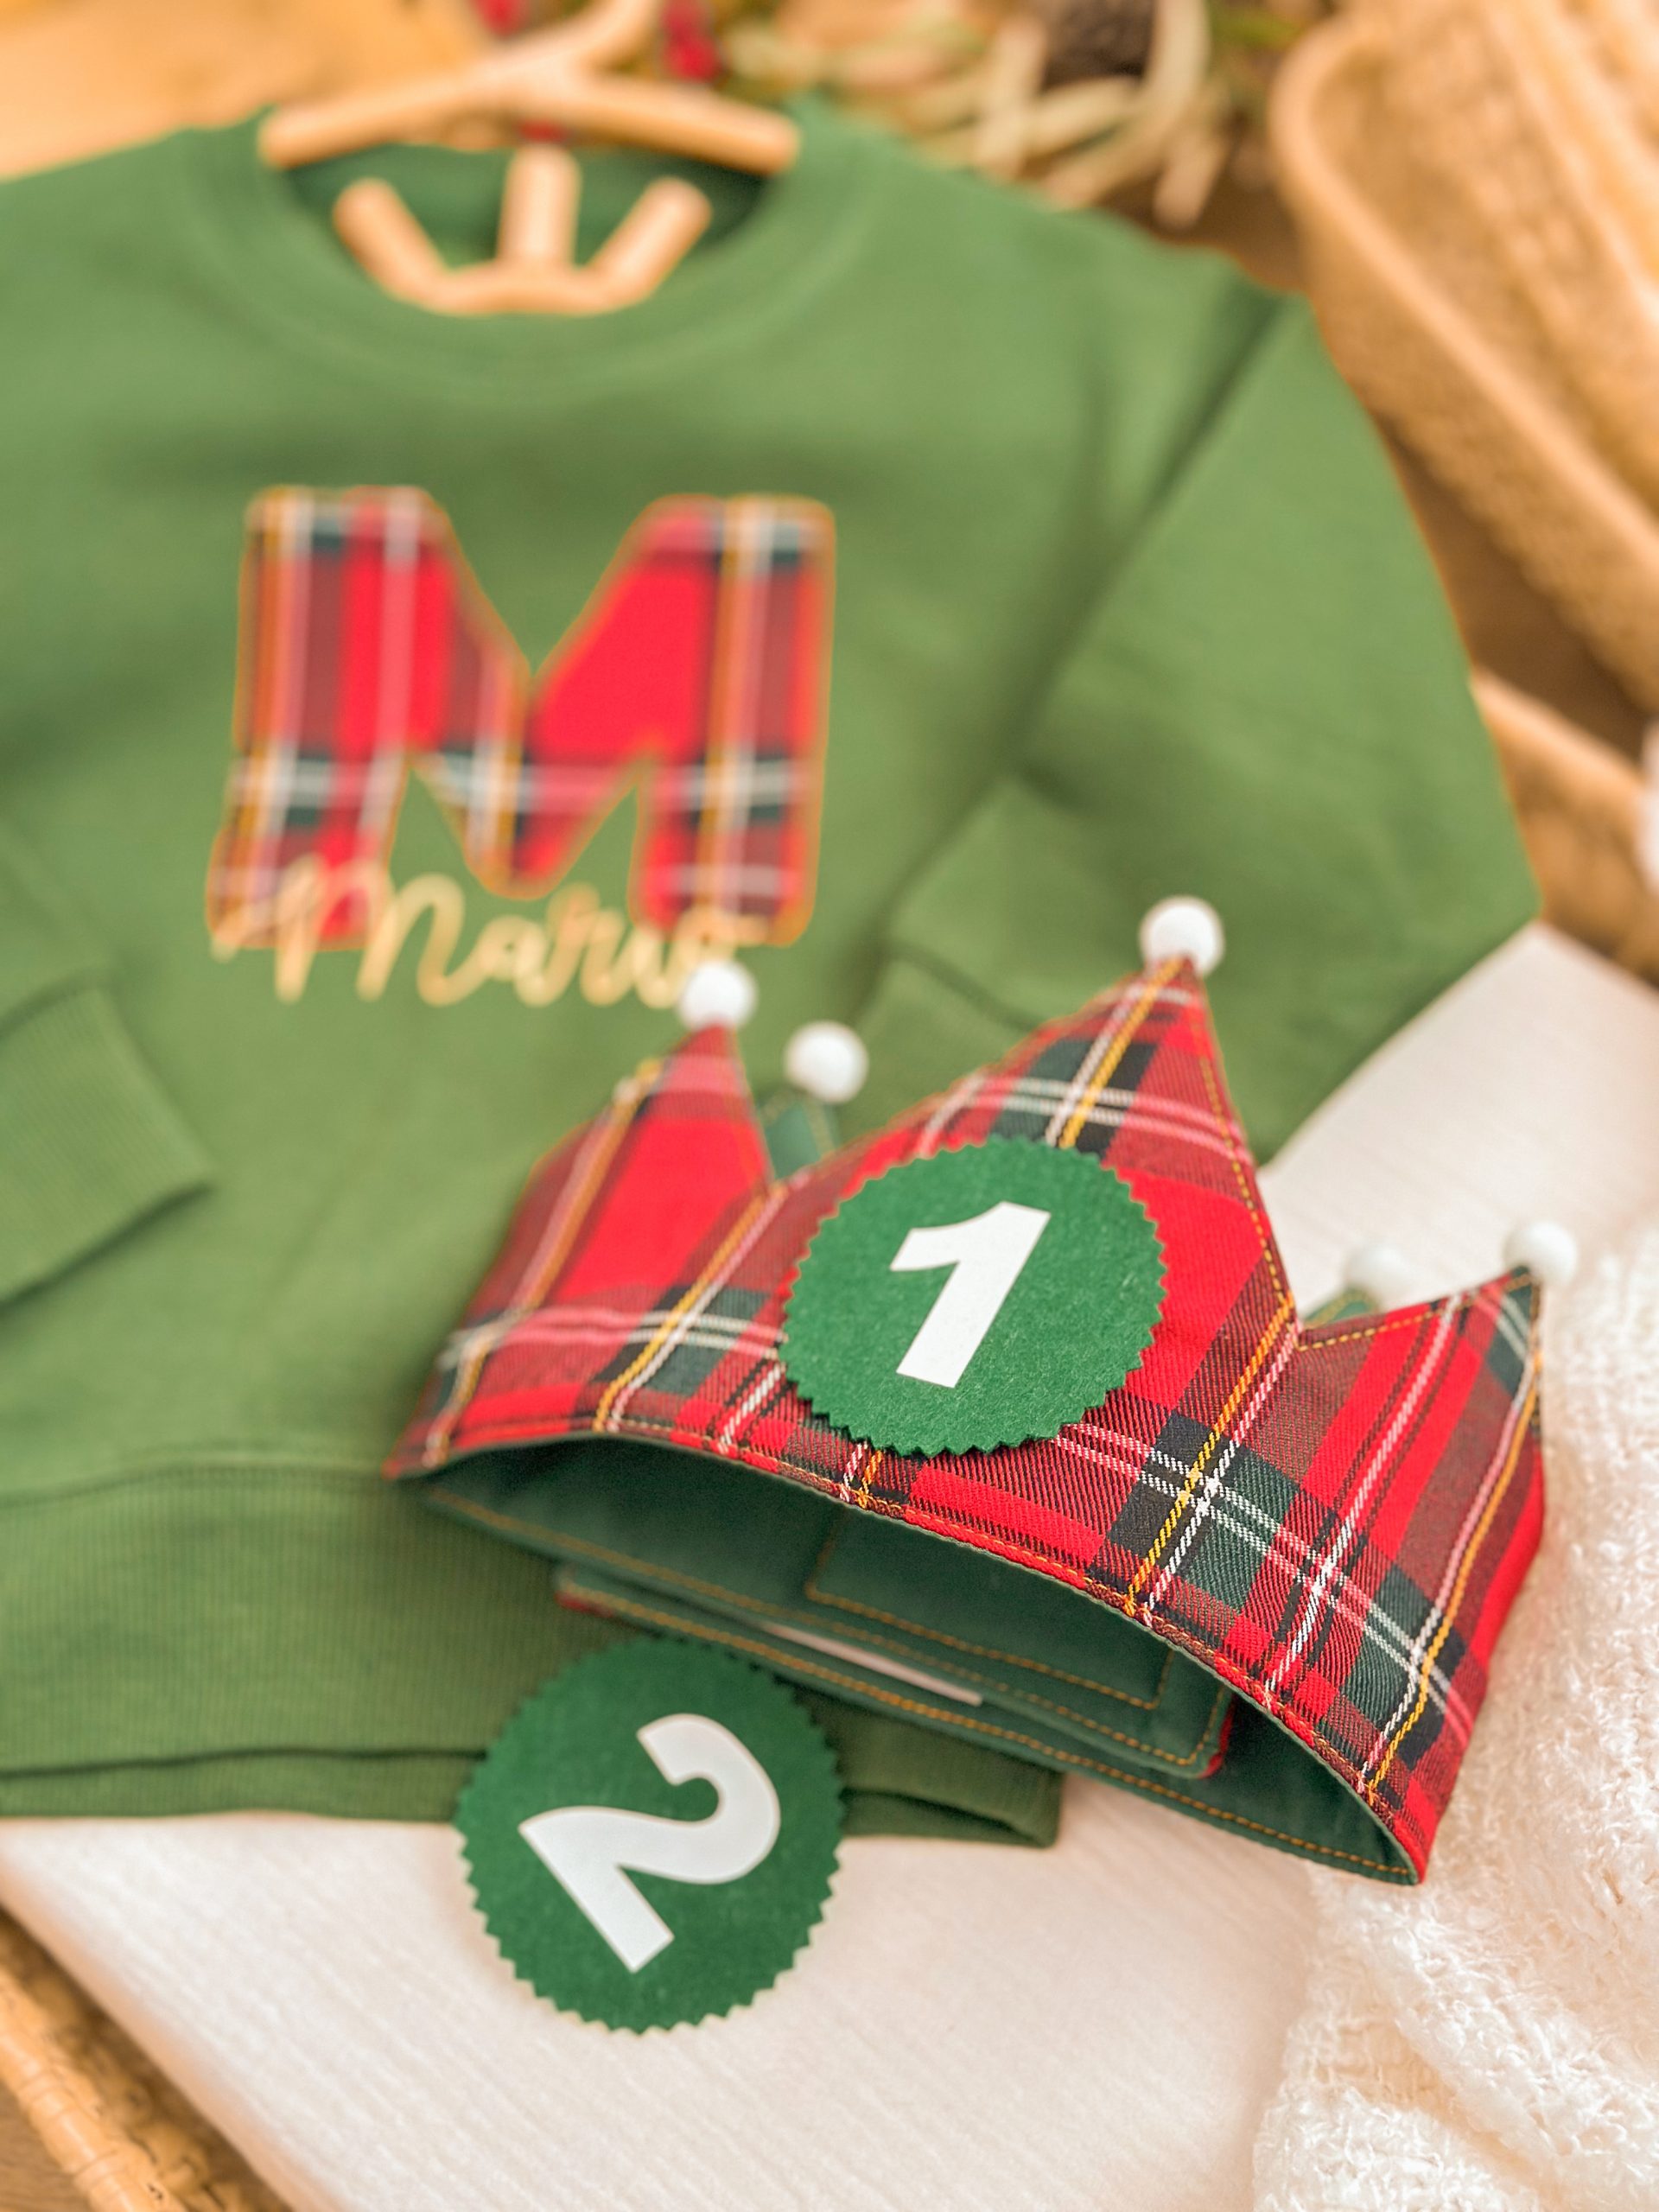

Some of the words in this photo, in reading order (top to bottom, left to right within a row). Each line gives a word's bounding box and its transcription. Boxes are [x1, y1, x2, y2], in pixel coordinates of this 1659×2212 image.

[206, 485, 836, 951] M
[889, 1200, 1052, 1389] 1
[518, 1713, 781, 1974] 2
